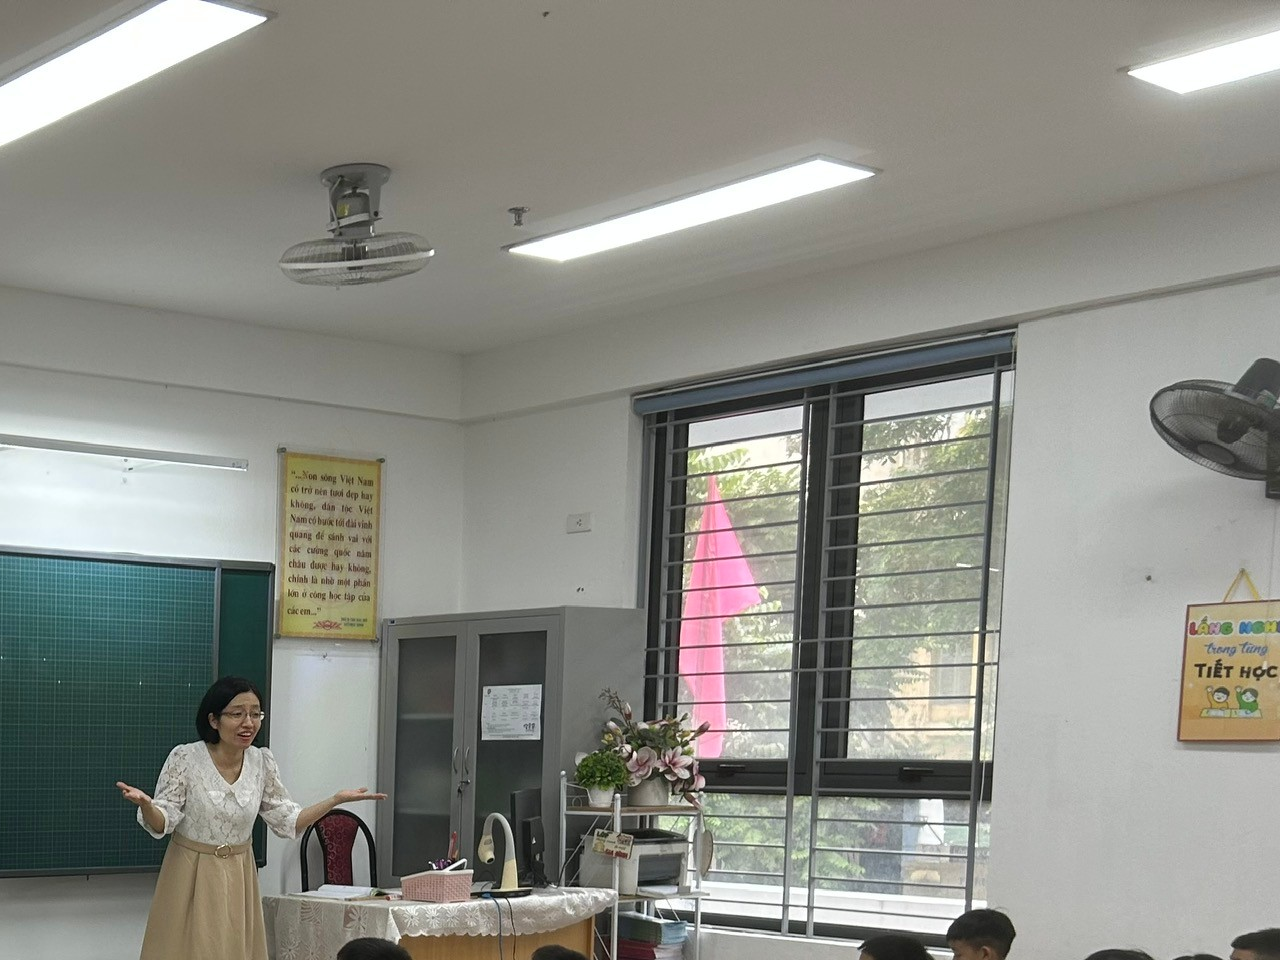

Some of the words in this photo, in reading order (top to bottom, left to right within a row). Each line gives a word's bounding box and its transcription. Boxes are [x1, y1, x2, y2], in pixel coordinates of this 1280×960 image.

[340, 474, 354, 486] Việt
[357, 476, 374, 488] Nam
[290, 484, 300, 493] có
[346, 490, 359, 501] đẹp
[361, 492, 373, 502] hay
[290, 514, 307, 524] Nam
[289, 531, 312, 541] quang
[348, 534, 358, 543] vai
[331, 562, 344, 573] hay
[329, 591, 341, 601] học
[1189, 616, 1233, 636] LẮNG
[1194, 658, 1234, 679] TIẾT
[1239, 664, 1278, 682] HỌC
